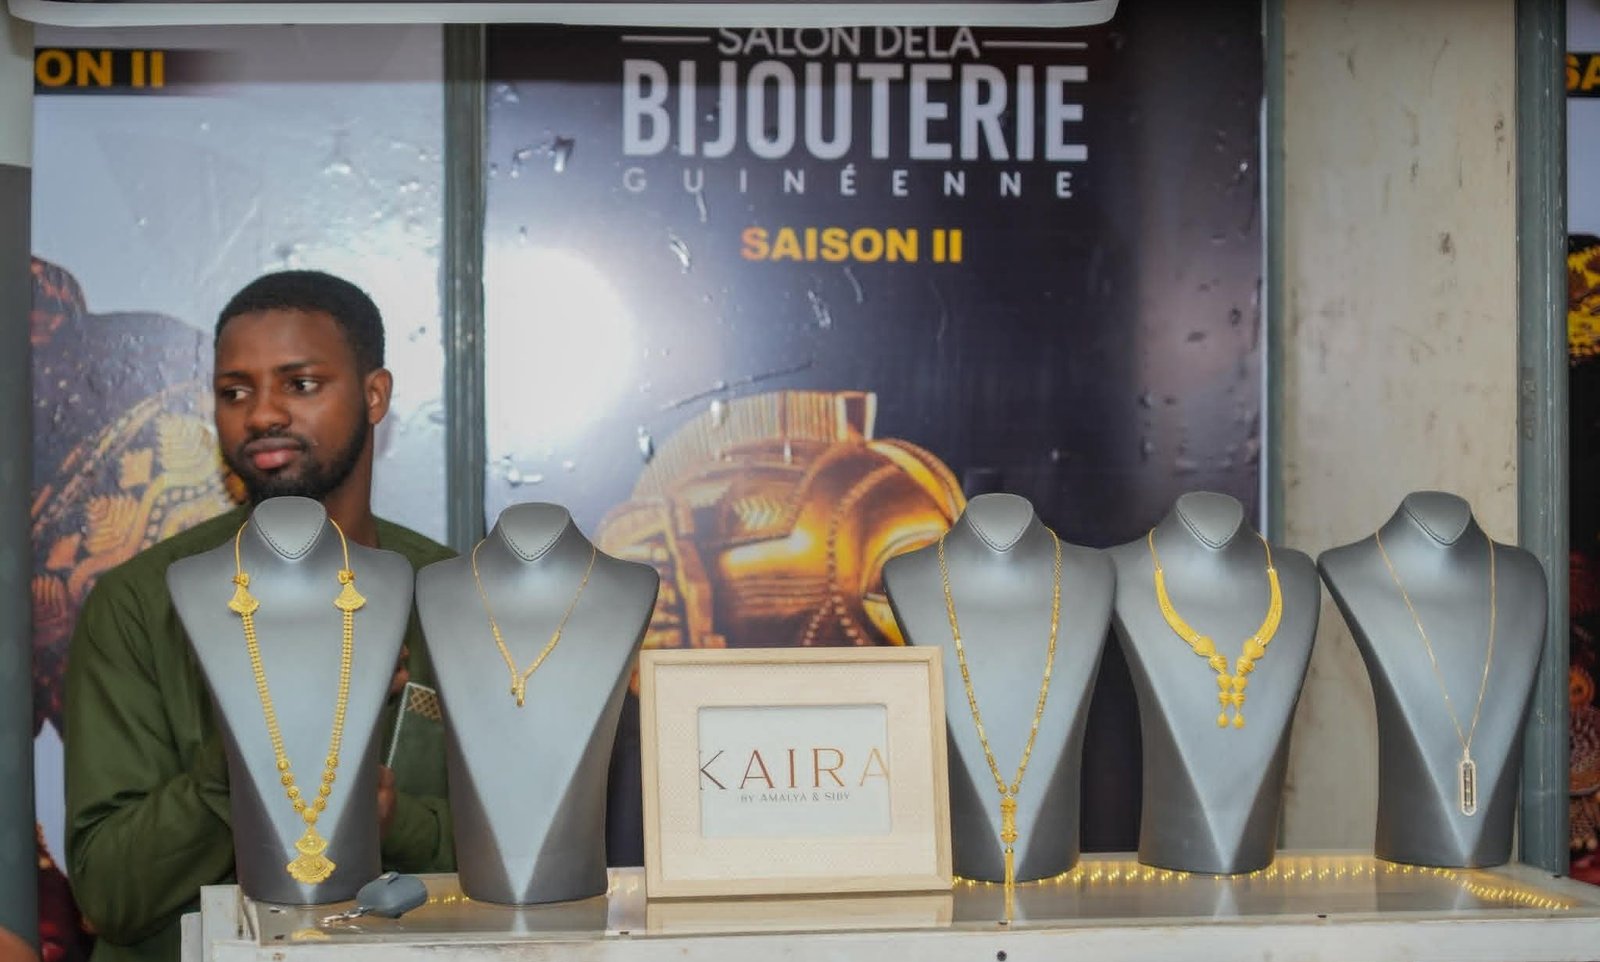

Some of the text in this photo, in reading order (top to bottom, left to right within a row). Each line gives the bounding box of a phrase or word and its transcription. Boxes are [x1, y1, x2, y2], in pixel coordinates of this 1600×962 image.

[718, 27, 860, 56] SALON
[131, 51, 164, 87] II
[622, 59, 1089, 161] BIJOUTERIE
[741, 226, 962, 263] SAISON II
[699, 748, 891, 790] KAIRA
[740, 795, 754, 803] BY
[761, 793, 807, 802] AMALYA
[812, 792, 820, 801] &
